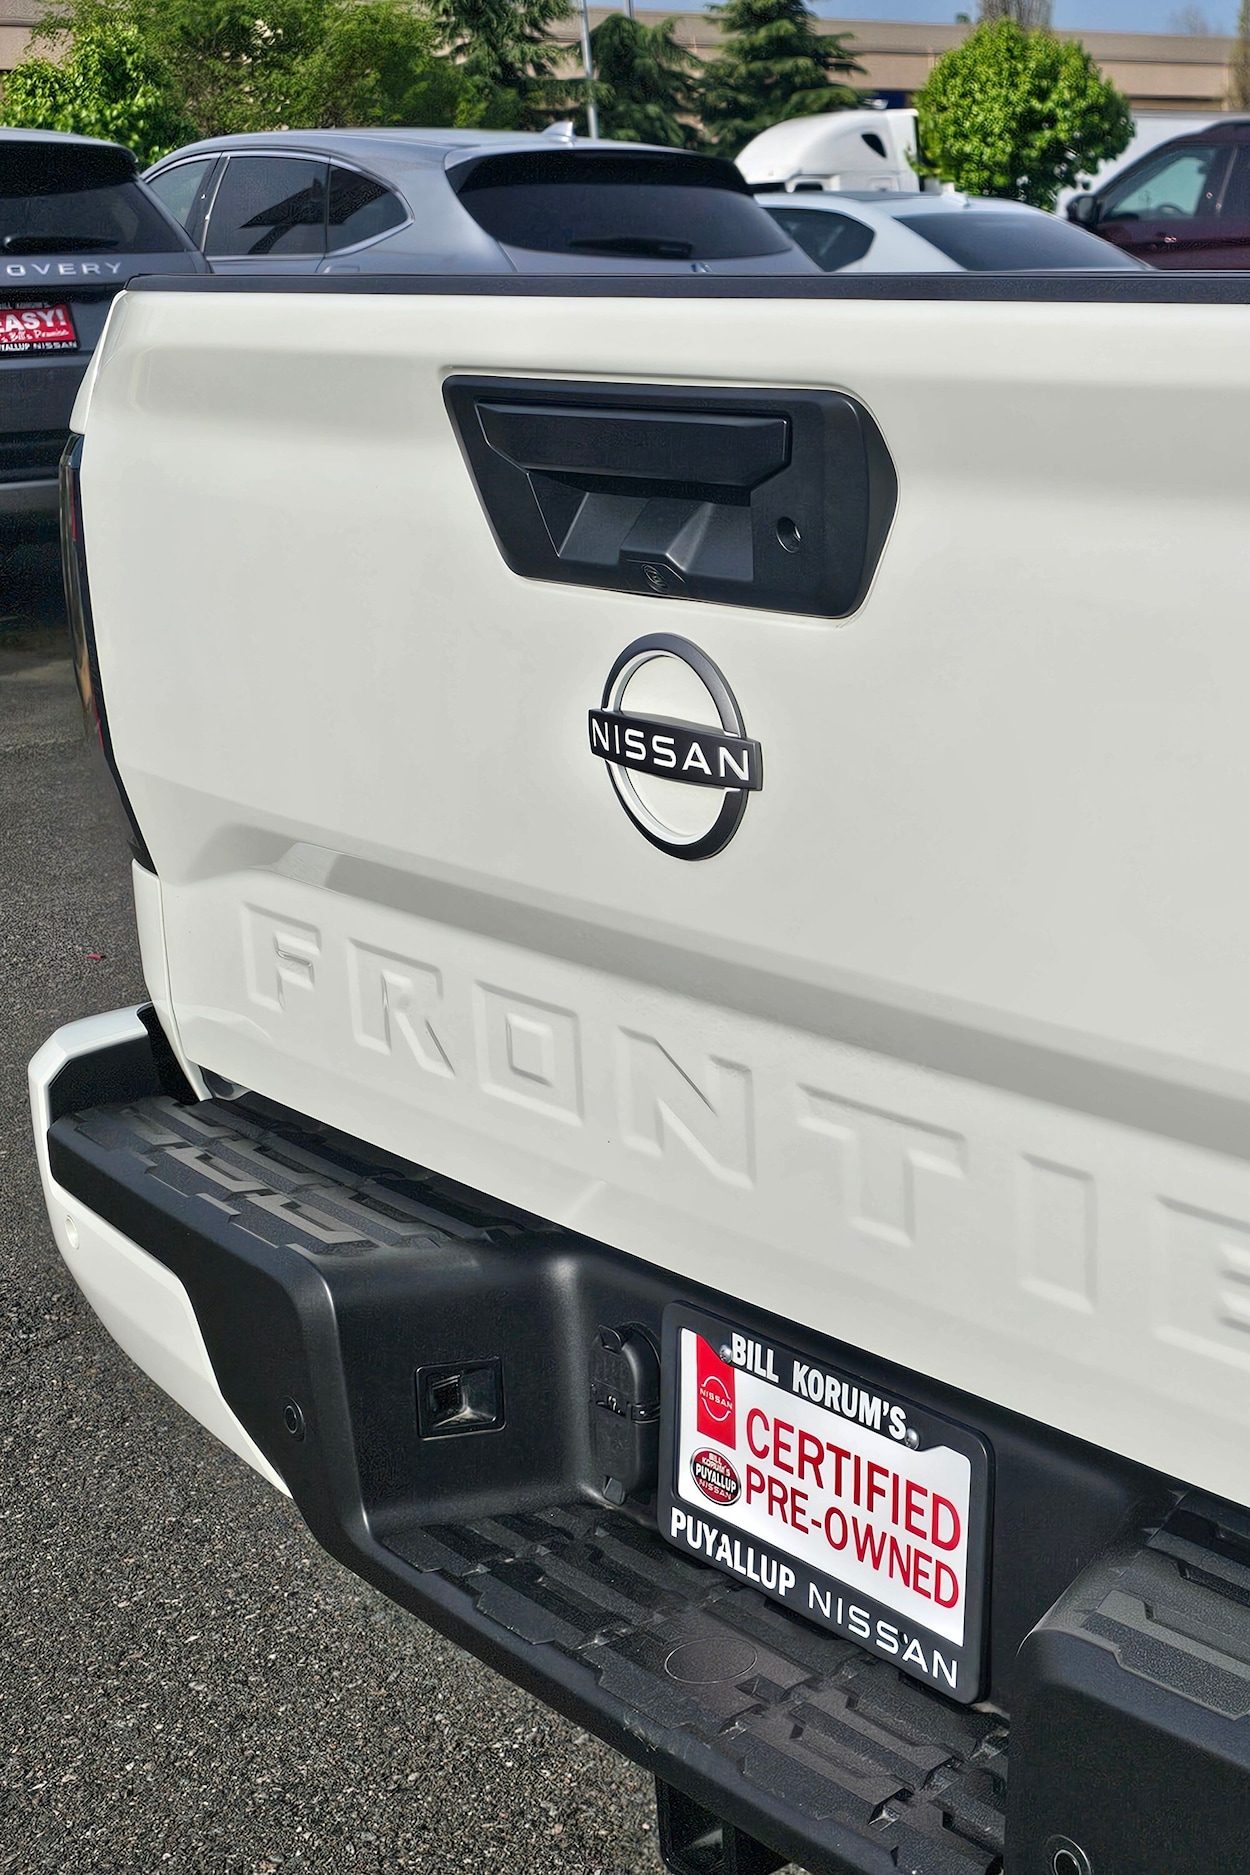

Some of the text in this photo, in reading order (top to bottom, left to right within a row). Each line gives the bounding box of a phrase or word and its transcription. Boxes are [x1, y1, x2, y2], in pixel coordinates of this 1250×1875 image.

[7, 262, 121, 277] OVERY
[592, 718, 749, 781] NISSAN
[699, 1387, 733, 1410] NISSAN
[732, 1332, 908, 1440] BILL KORUM'S
[695, 1462, 737, 1493] PUYALLUP
[699, 1478, 732, 1500] NISSAN
[746, 1407, 961, 1552] CERTIFIED
[746, 1463, 960, 1609] PRE-OWNED
[670, 1506, 958, 1689] PUYALLUP NISSAN
